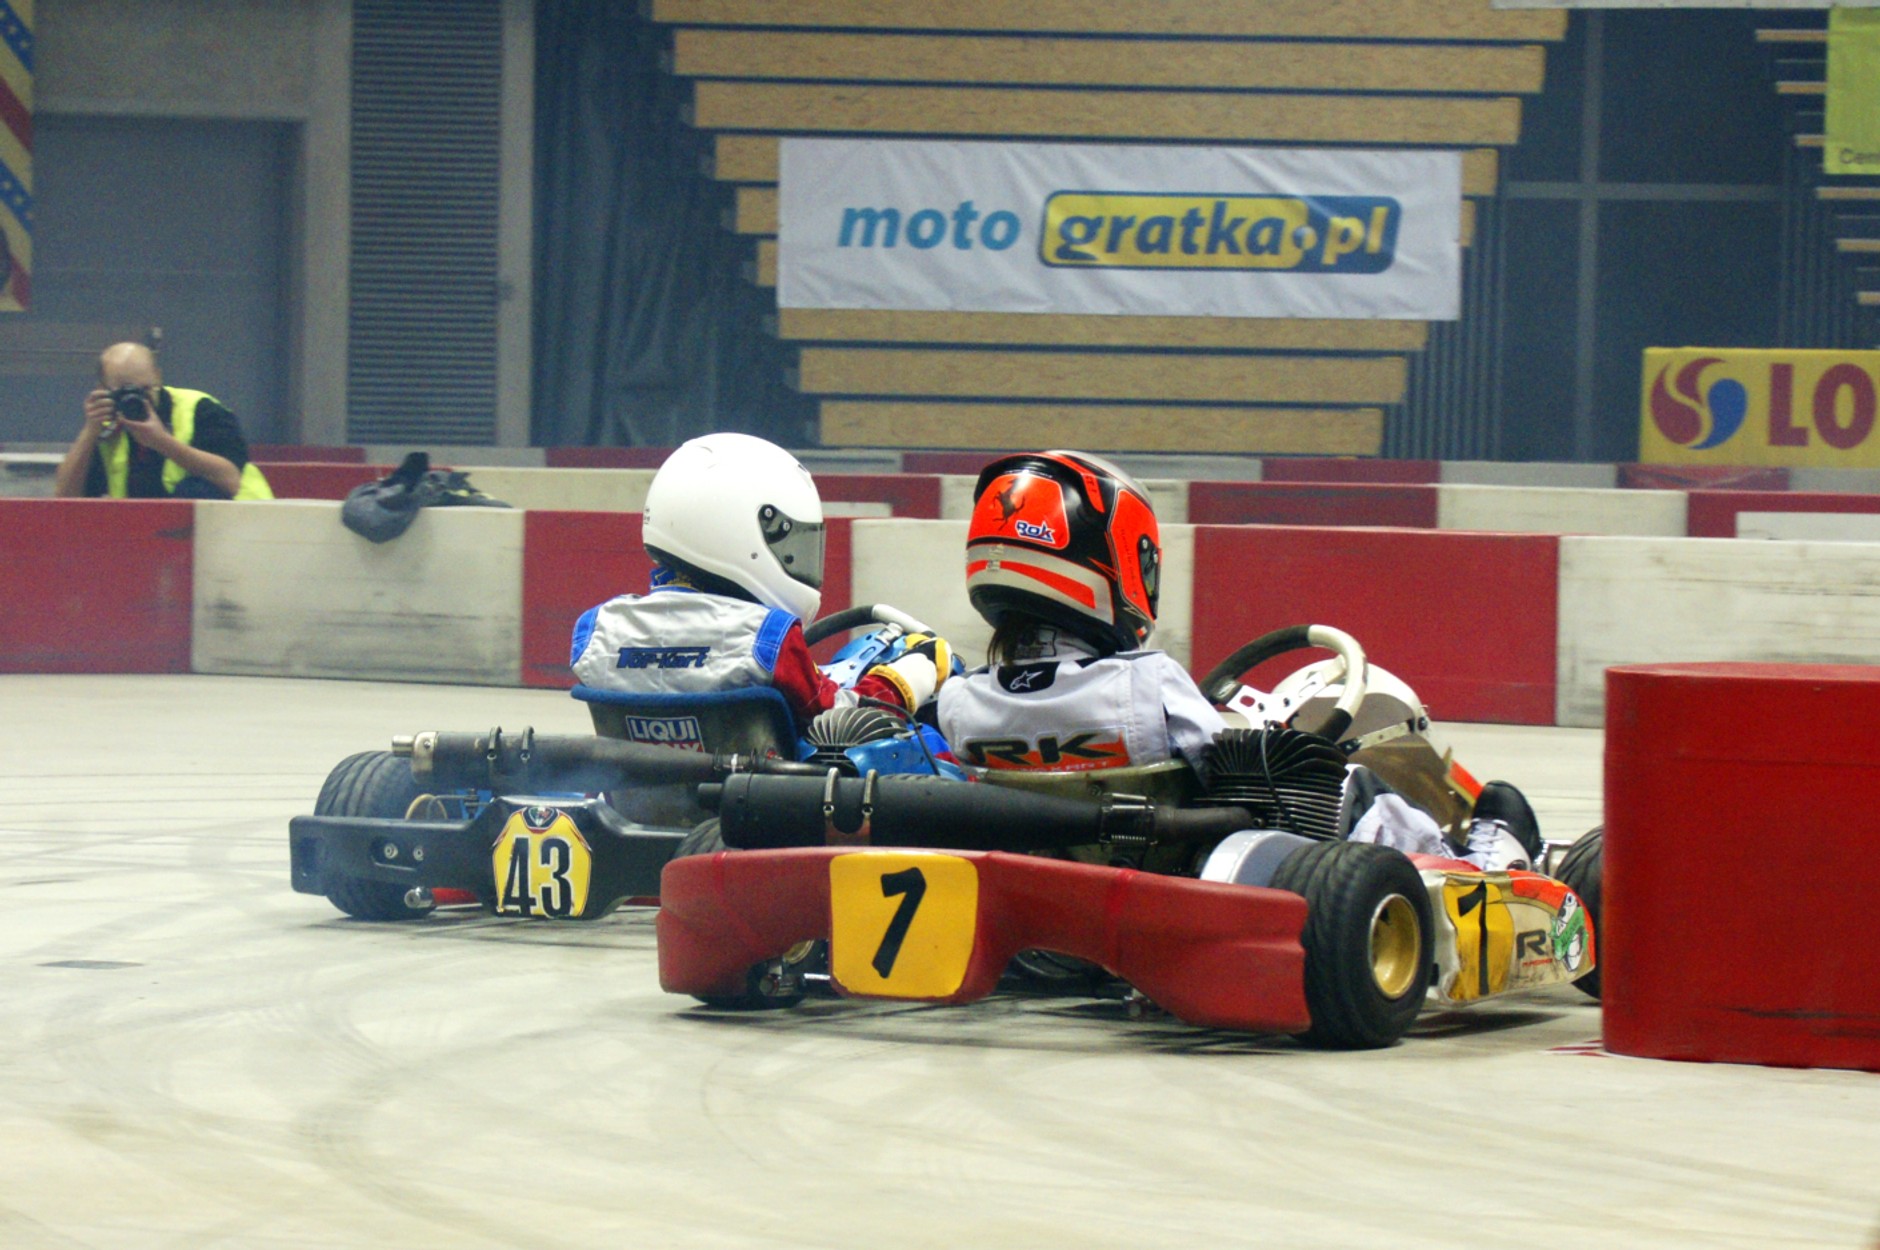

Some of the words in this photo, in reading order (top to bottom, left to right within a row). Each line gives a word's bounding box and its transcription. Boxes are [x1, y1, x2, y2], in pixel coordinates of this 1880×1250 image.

[838, 199, 1021, 251] moto
[1054, 200, 1389, 266] gratka.pl
[1768, 362, 1877, 450] LO
[630, 719, 697, 741] LIQUI
[966, 733, 1118, 766] RK
[499, 835, 573, 917] 43
